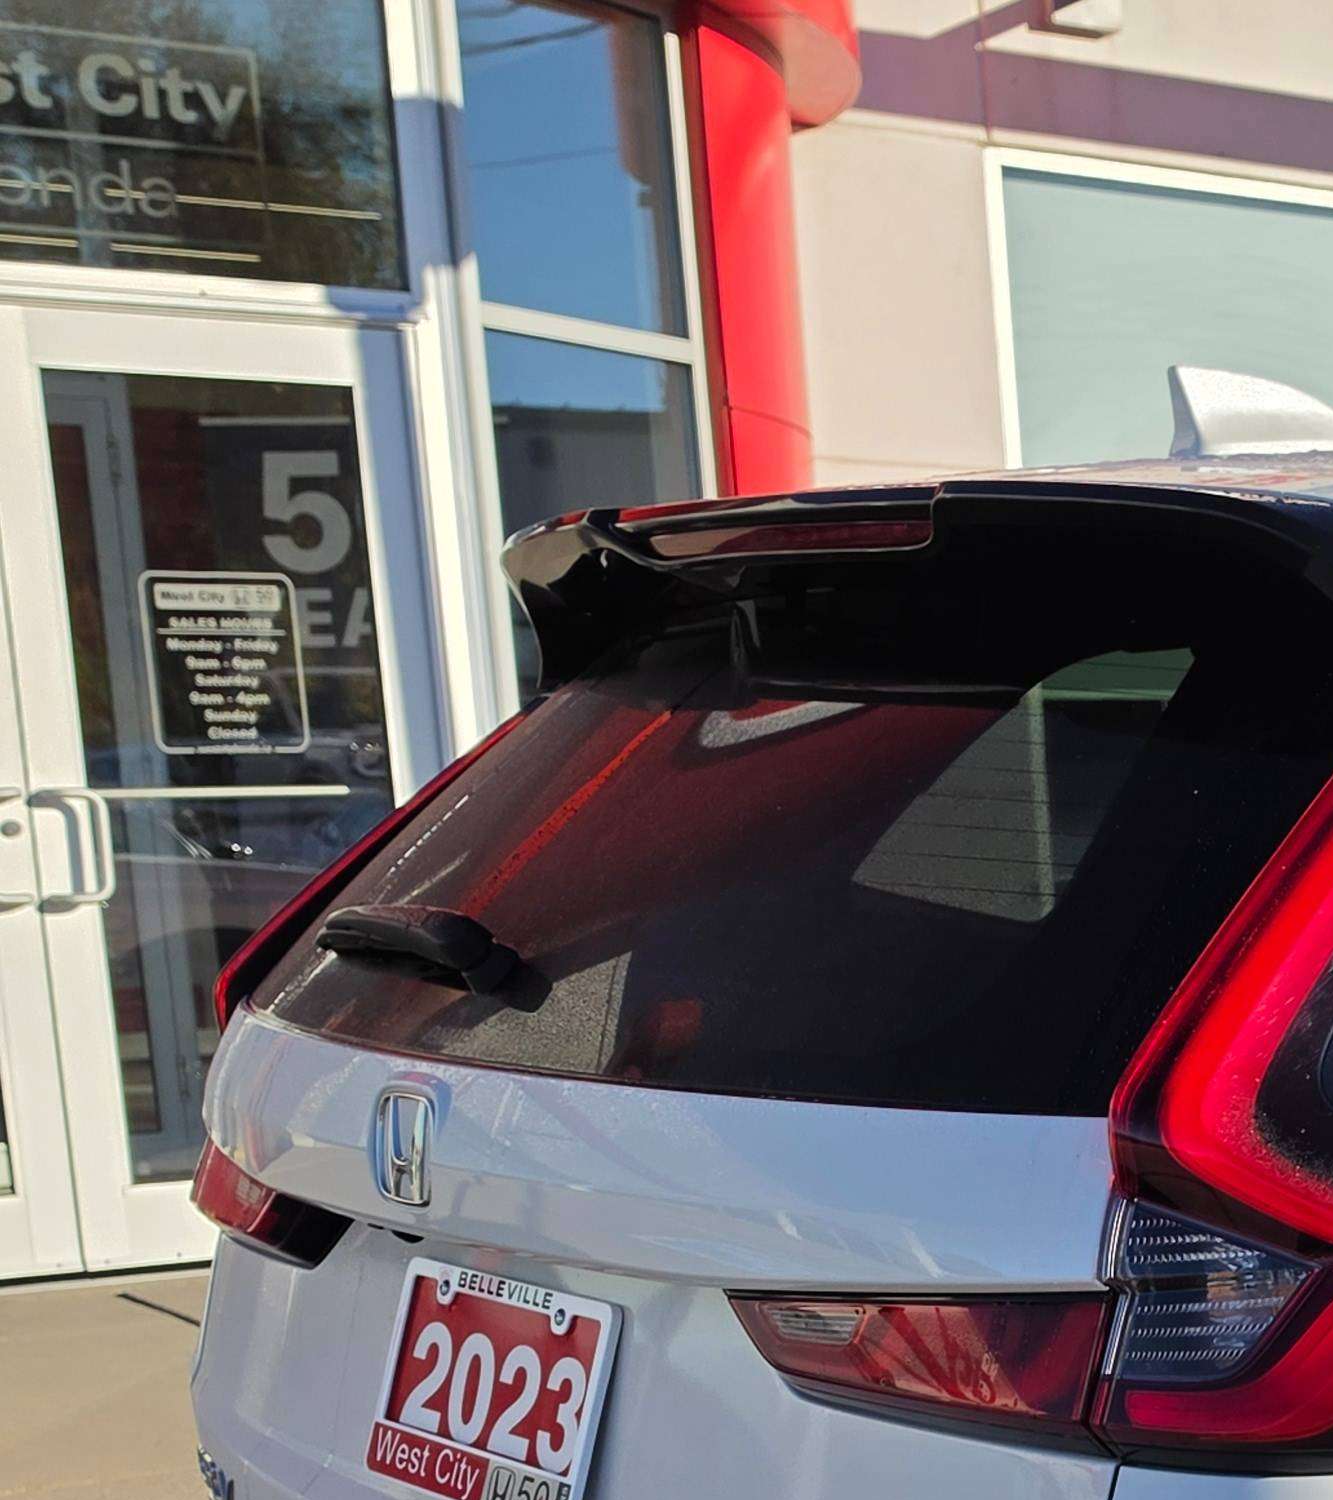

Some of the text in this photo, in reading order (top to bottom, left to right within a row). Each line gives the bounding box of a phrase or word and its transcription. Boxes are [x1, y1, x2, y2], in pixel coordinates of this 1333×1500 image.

[78, 53, 246, 142] City
[261, 450, 352, 574] 5
[168, 616, 217, 629] SALES
[166, 637, 223, 654] Monday
[234, 638, 279, 655] Friday
[195, 673, 259, 689] Saturday
[204, 709, 258, 725] Sunday
[208, 726, 258, 739] Closed
[457, 1271, 553, 1310] BELLEVILLE
[399, 1321, 587, 1474] 2023
[374, 1427, 430, 1477] West
[434, 1449, 481, 1500] City
